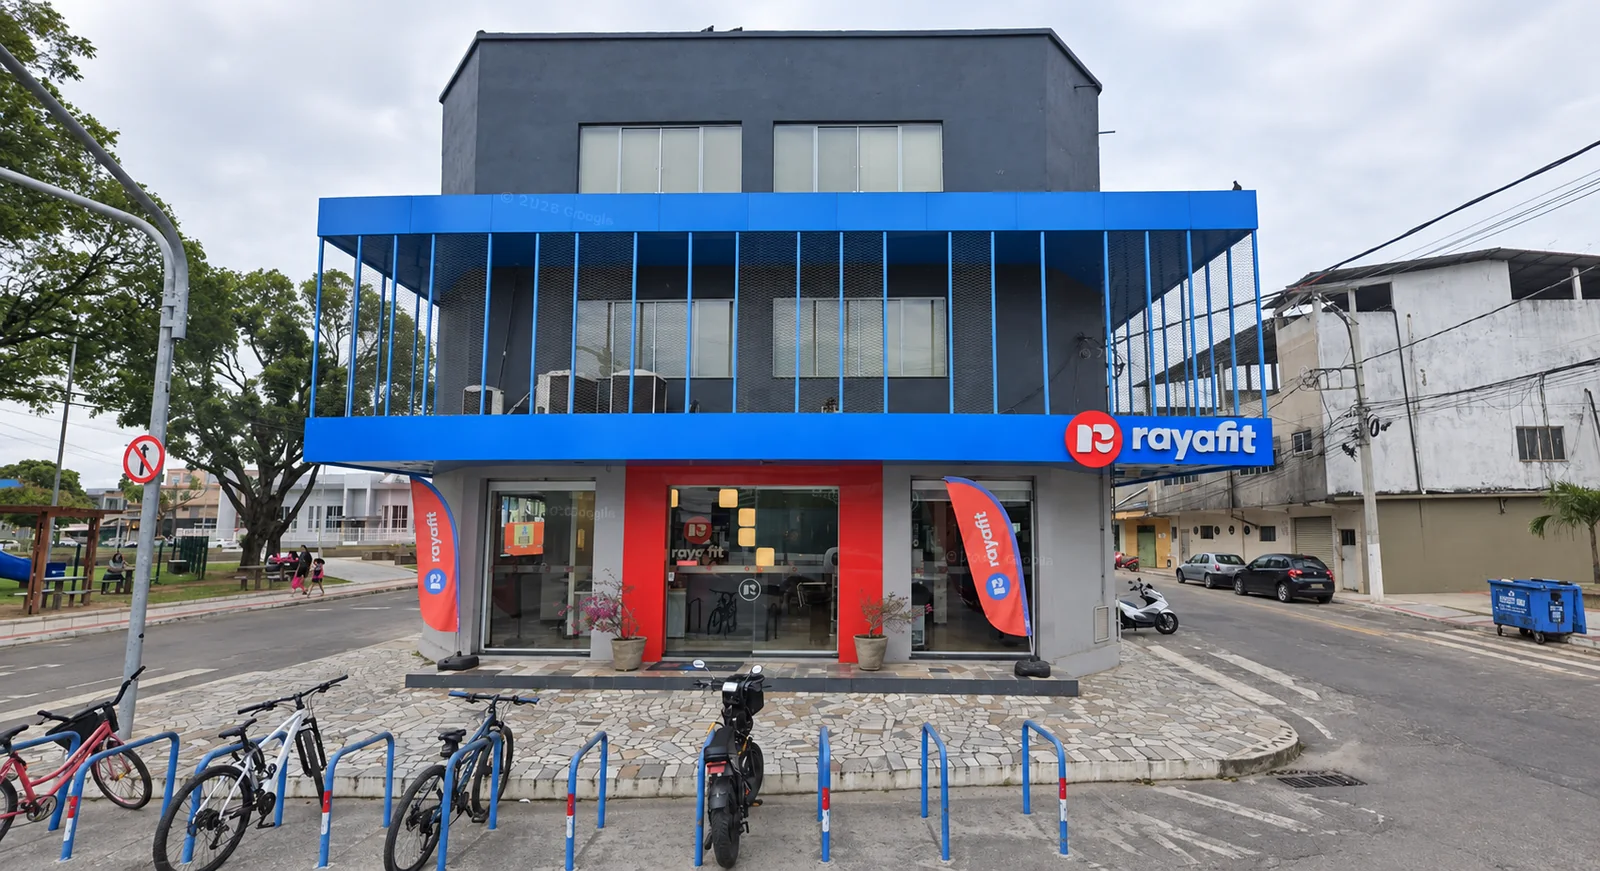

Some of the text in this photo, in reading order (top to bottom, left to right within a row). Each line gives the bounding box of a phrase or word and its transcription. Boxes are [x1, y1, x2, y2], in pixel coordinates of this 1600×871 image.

[1132, 420, 1256, 461] rayafit
[426, 511, 442, 563] rayafit
[974, 511, 1000, 568] rayafit
